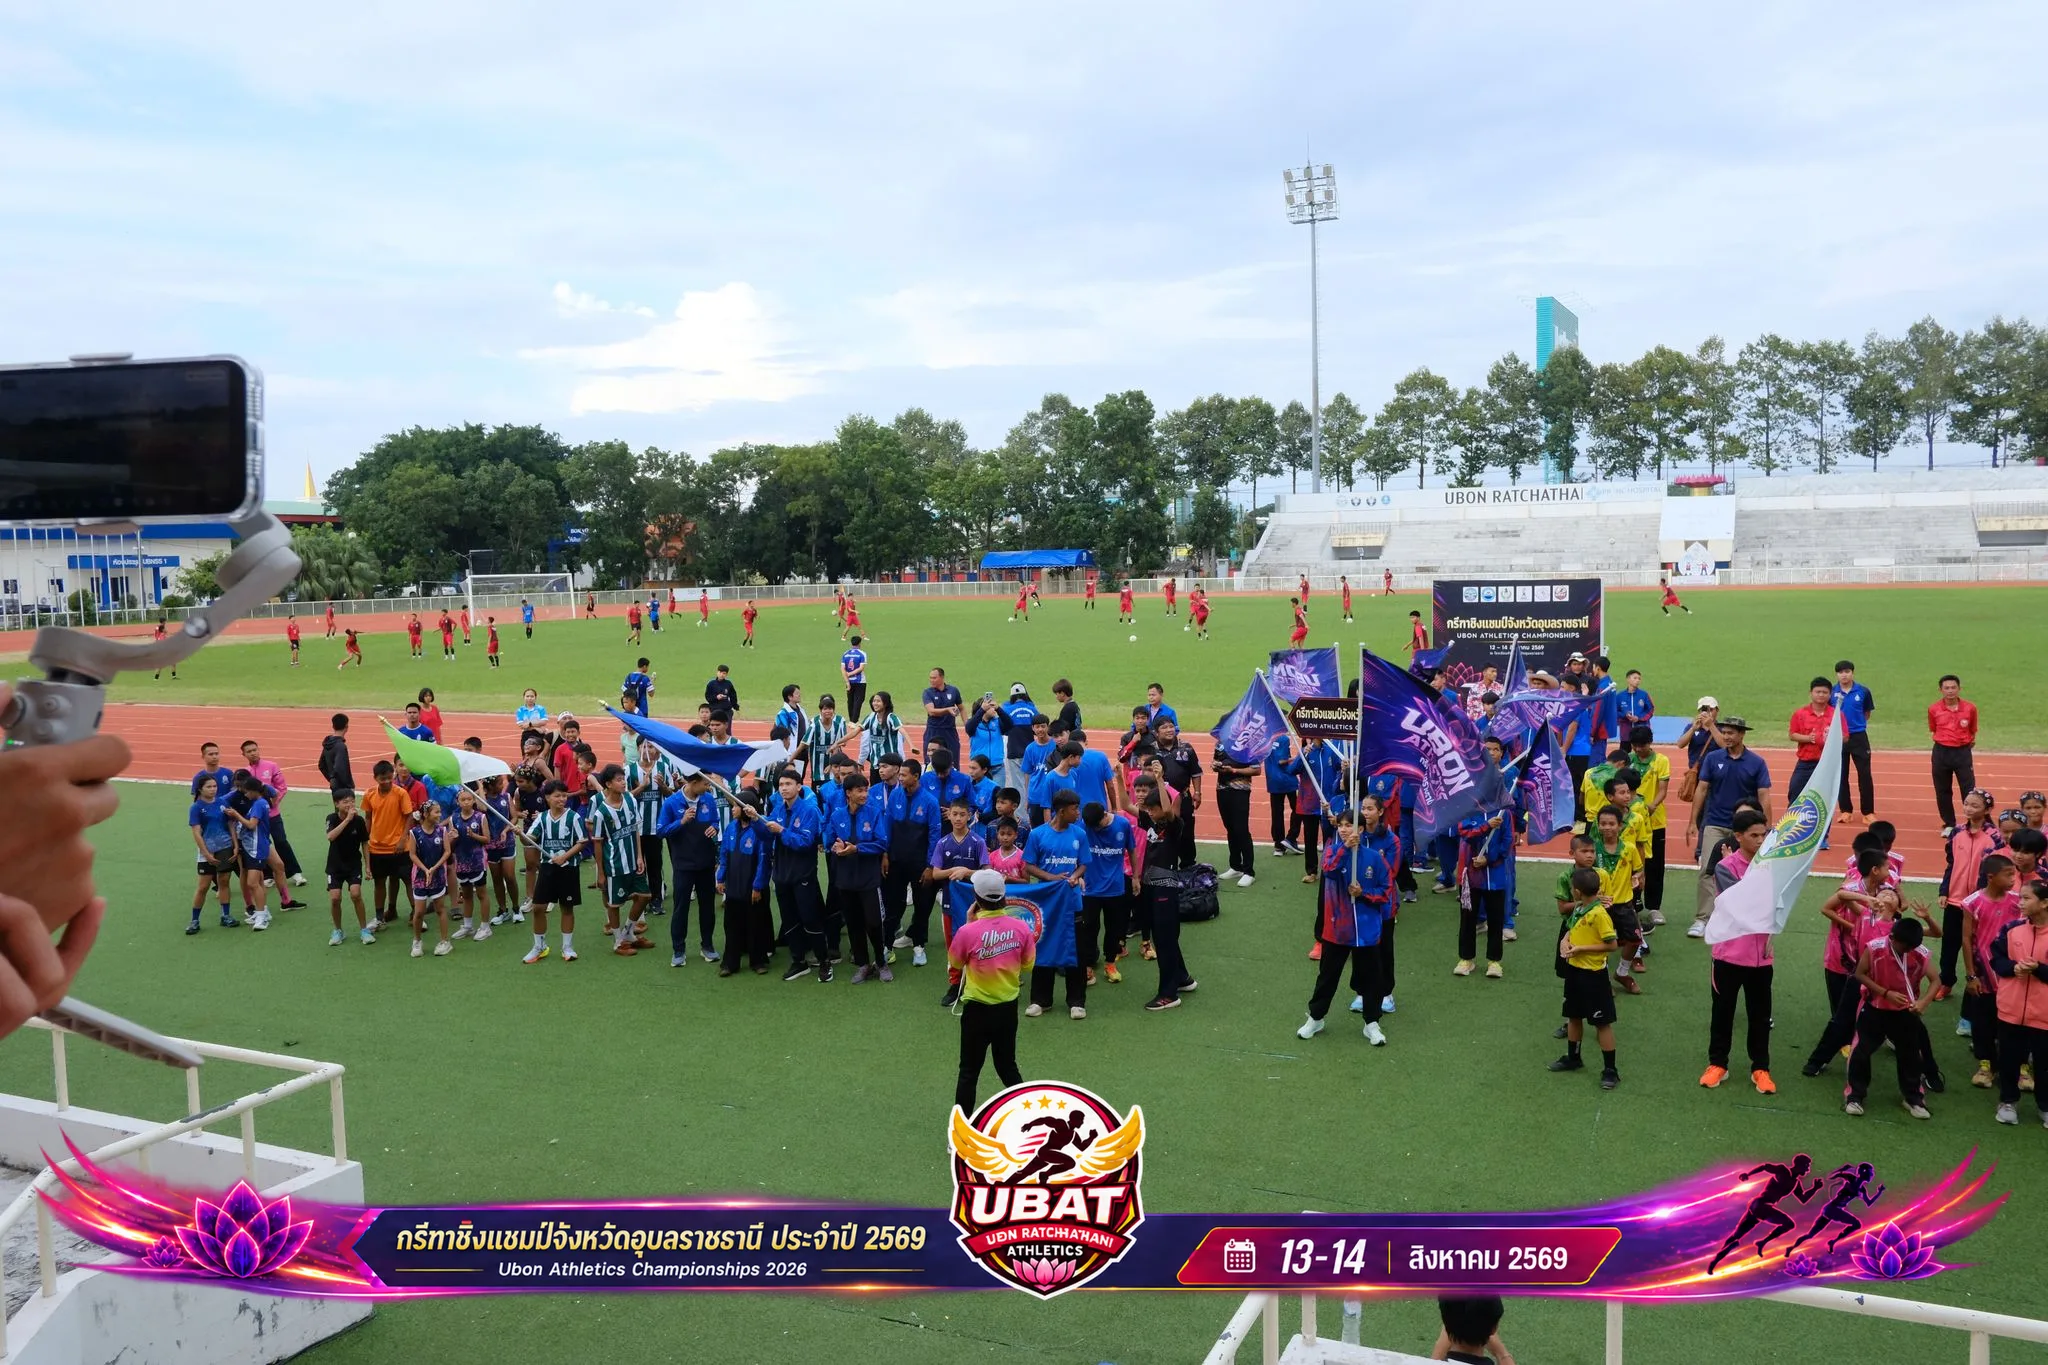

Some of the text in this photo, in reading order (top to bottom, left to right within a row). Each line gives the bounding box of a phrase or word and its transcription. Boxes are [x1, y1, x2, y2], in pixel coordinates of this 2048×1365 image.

[1445, 491, 1487, 505] UBON
[1401, 706, 1475, 796] UBON
[981, 929, 1014, 948] Ubon
